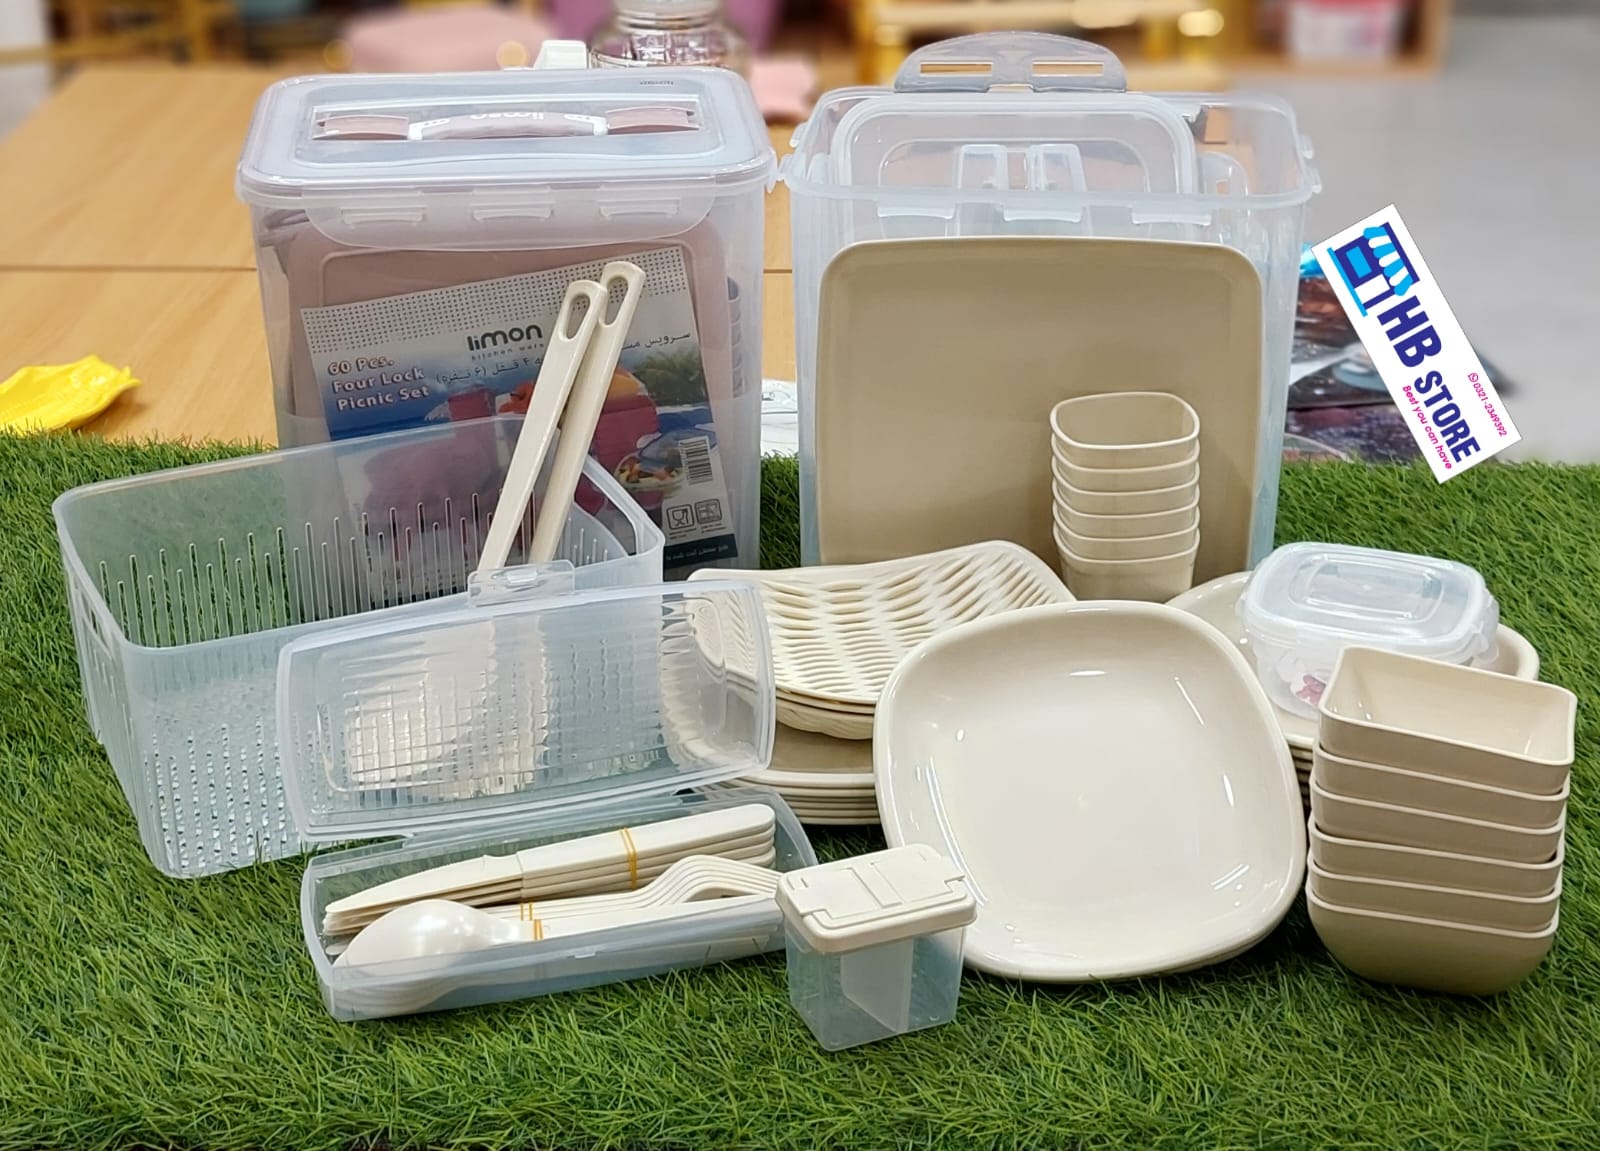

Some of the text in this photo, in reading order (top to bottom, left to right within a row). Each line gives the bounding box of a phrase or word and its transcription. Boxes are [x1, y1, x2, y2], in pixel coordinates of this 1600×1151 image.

[467, 325, 543, 351] limon
[328, 356, 393, 375] 60 Pcs.
[333, 367, 424, 393] Four Lock
[337, 385, 430, 412] Picnic Set
